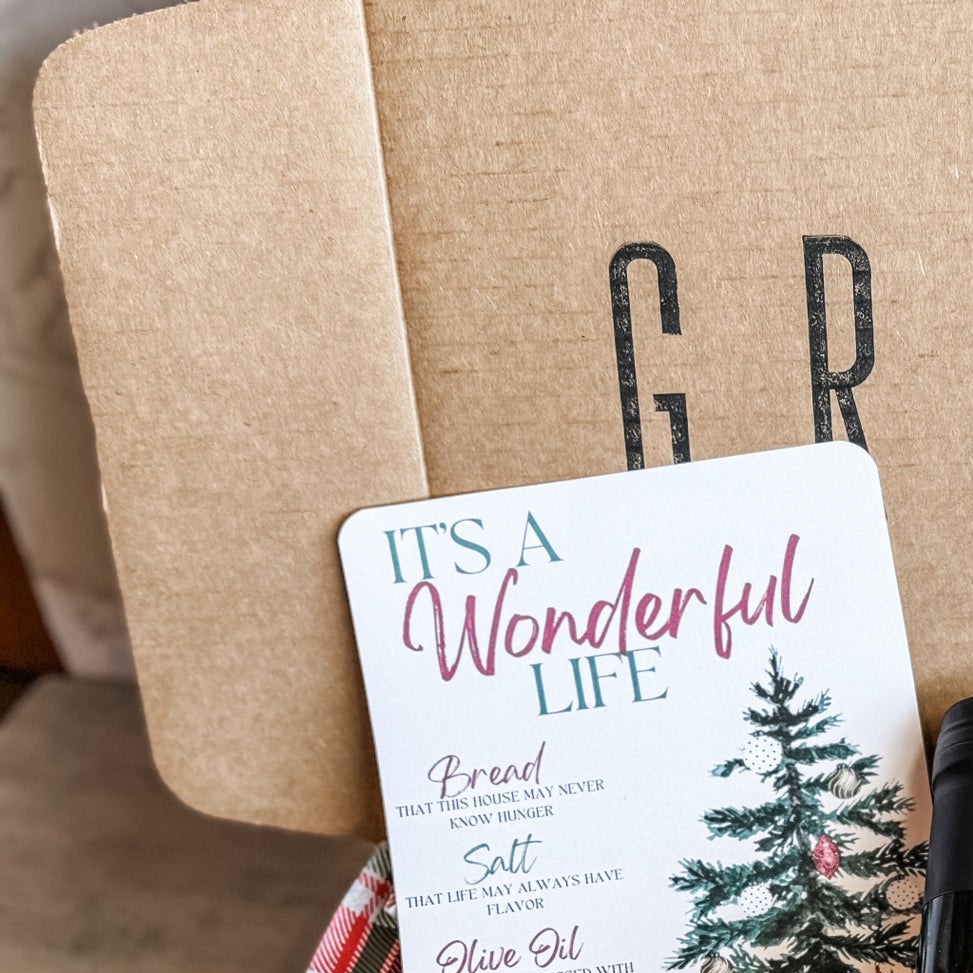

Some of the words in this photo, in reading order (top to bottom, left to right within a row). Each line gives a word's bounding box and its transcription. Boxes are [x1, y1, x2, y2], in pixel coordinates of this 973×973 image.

[383, 517, 492, 584] IT'S
[515, 510, 564, 567] A
[402, 534, 814, 682] Wonderful
[529, 646, 668, 716] LIFE
[427, 741, 546, 799] Bread
[396, 802, 434, 818] THAT
[437, 797, 470, 813] THIS
[473, 791, 519, 808] HOUSE
[523, 786, 554, 800] MAY
[558, 779, 605, 796] NEVER
[450, 813, 493, 829] KNOW
[498, 805, 554, 823] HUNGER
[463, 834, 543, 885] Salt
[405, 893, 443, 909] THAT
[447, 888, 478, 904] LIFE
[481, 883, 514, 899] MAY
[517, 874, 581, 894] ALWAYS
[584, 868, 624, 884] HAVE
[486, 897, 544, 916] FLAVOR
[528, 925, 585, 968] Oil
